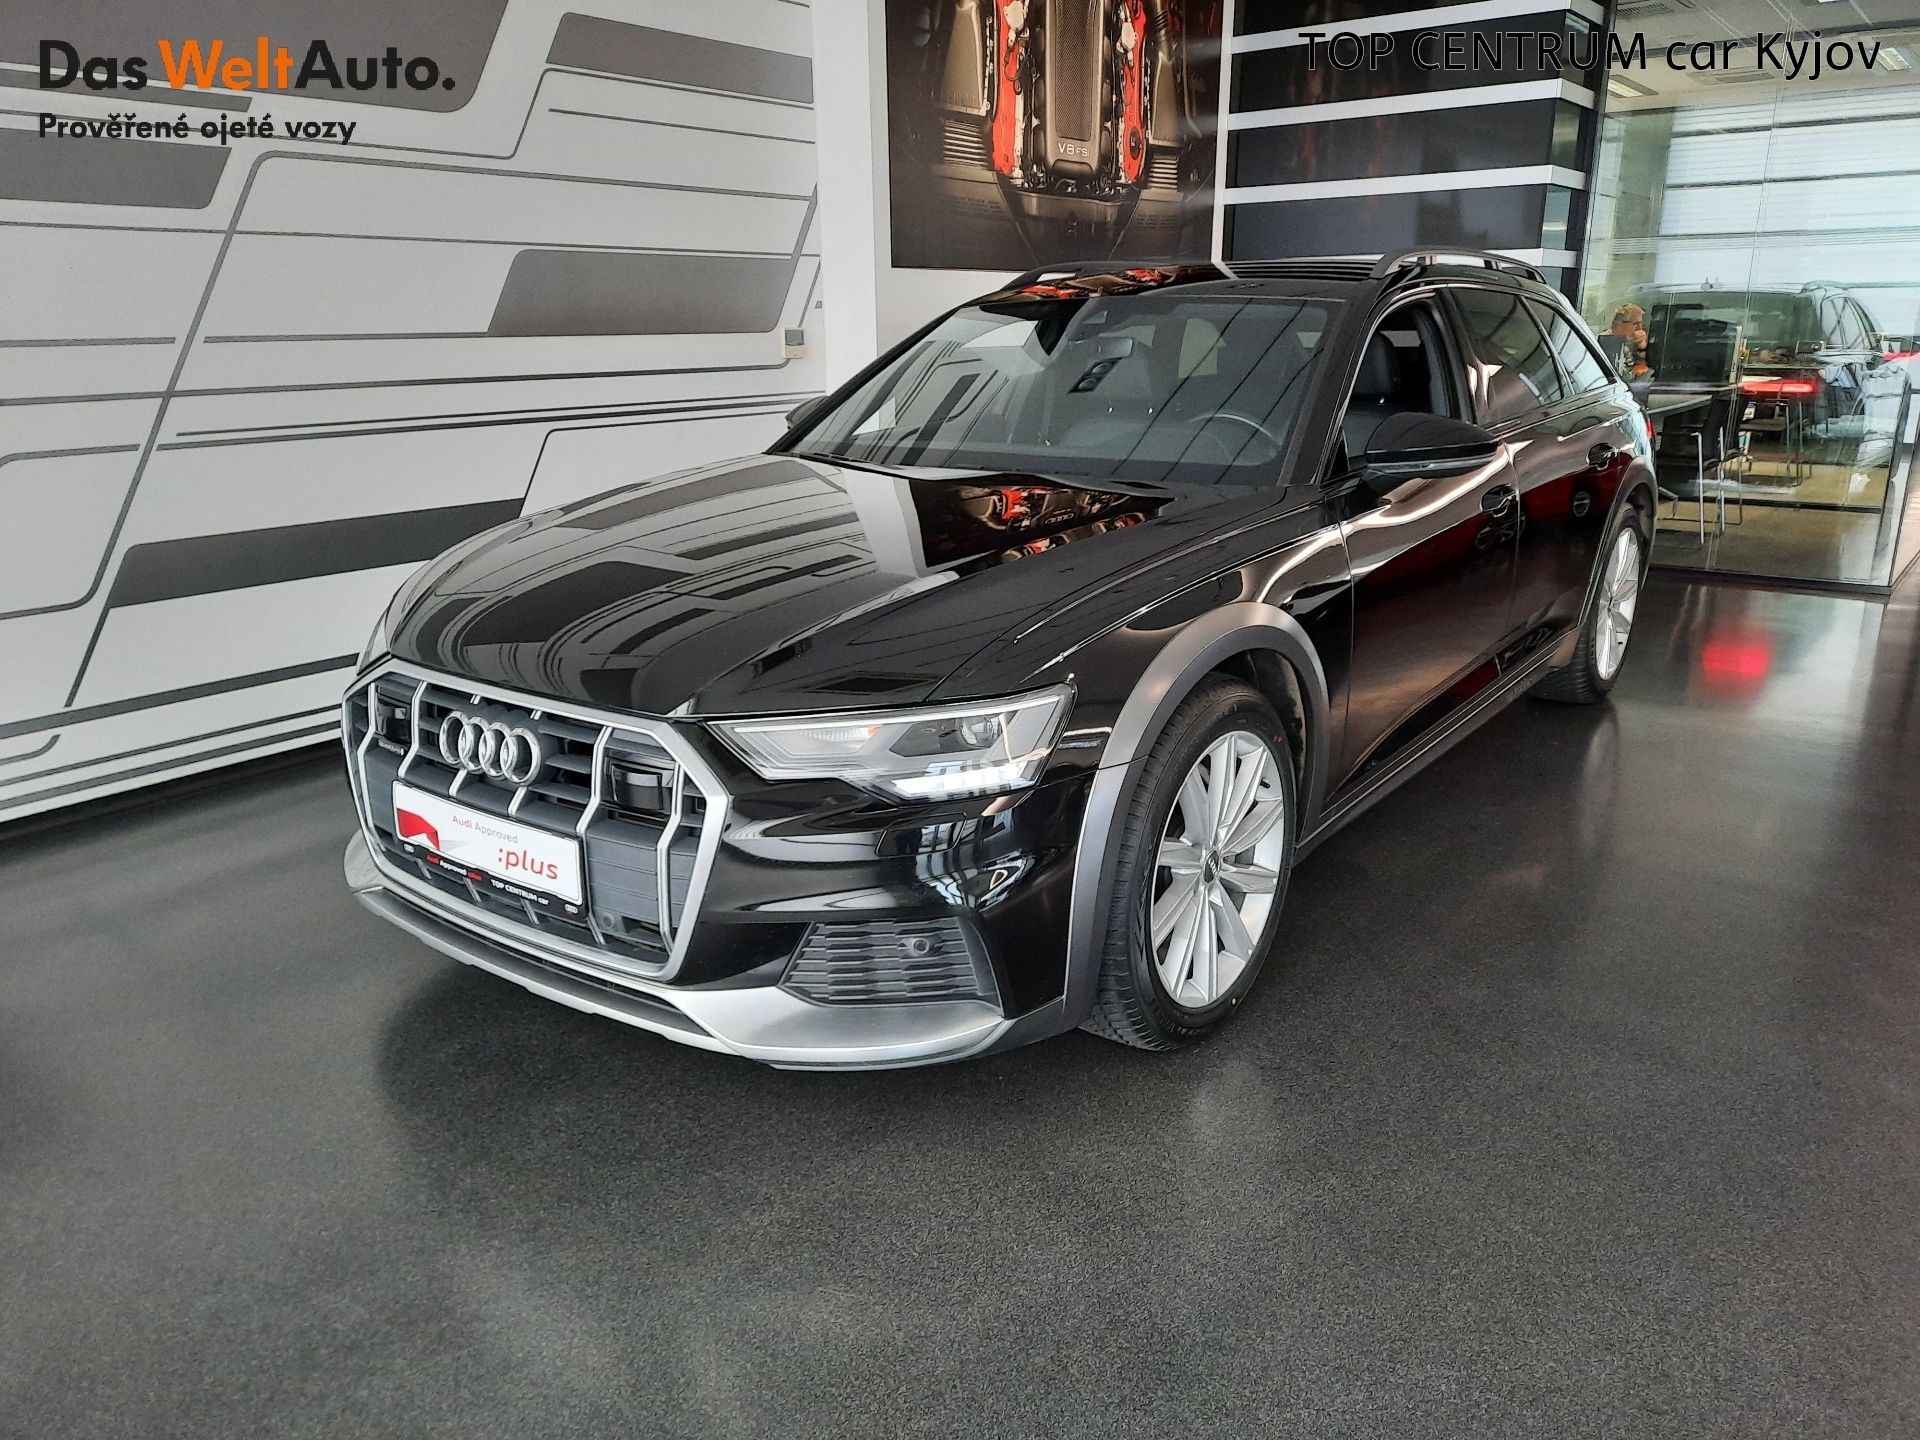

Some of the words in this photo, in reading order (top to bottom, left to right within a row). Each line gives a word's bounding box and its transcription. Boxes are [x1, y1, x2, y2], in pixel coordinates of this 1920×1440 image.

[1058, 142, 1075, 155] V8
[452, 815, 473, 828] Audi
[475, 822, 518, 844] Approved
[498, 847, 558, 880] :plus
[490, 879, 505, 889] TOP
[504, 884, 538, 902] CENTRUM
